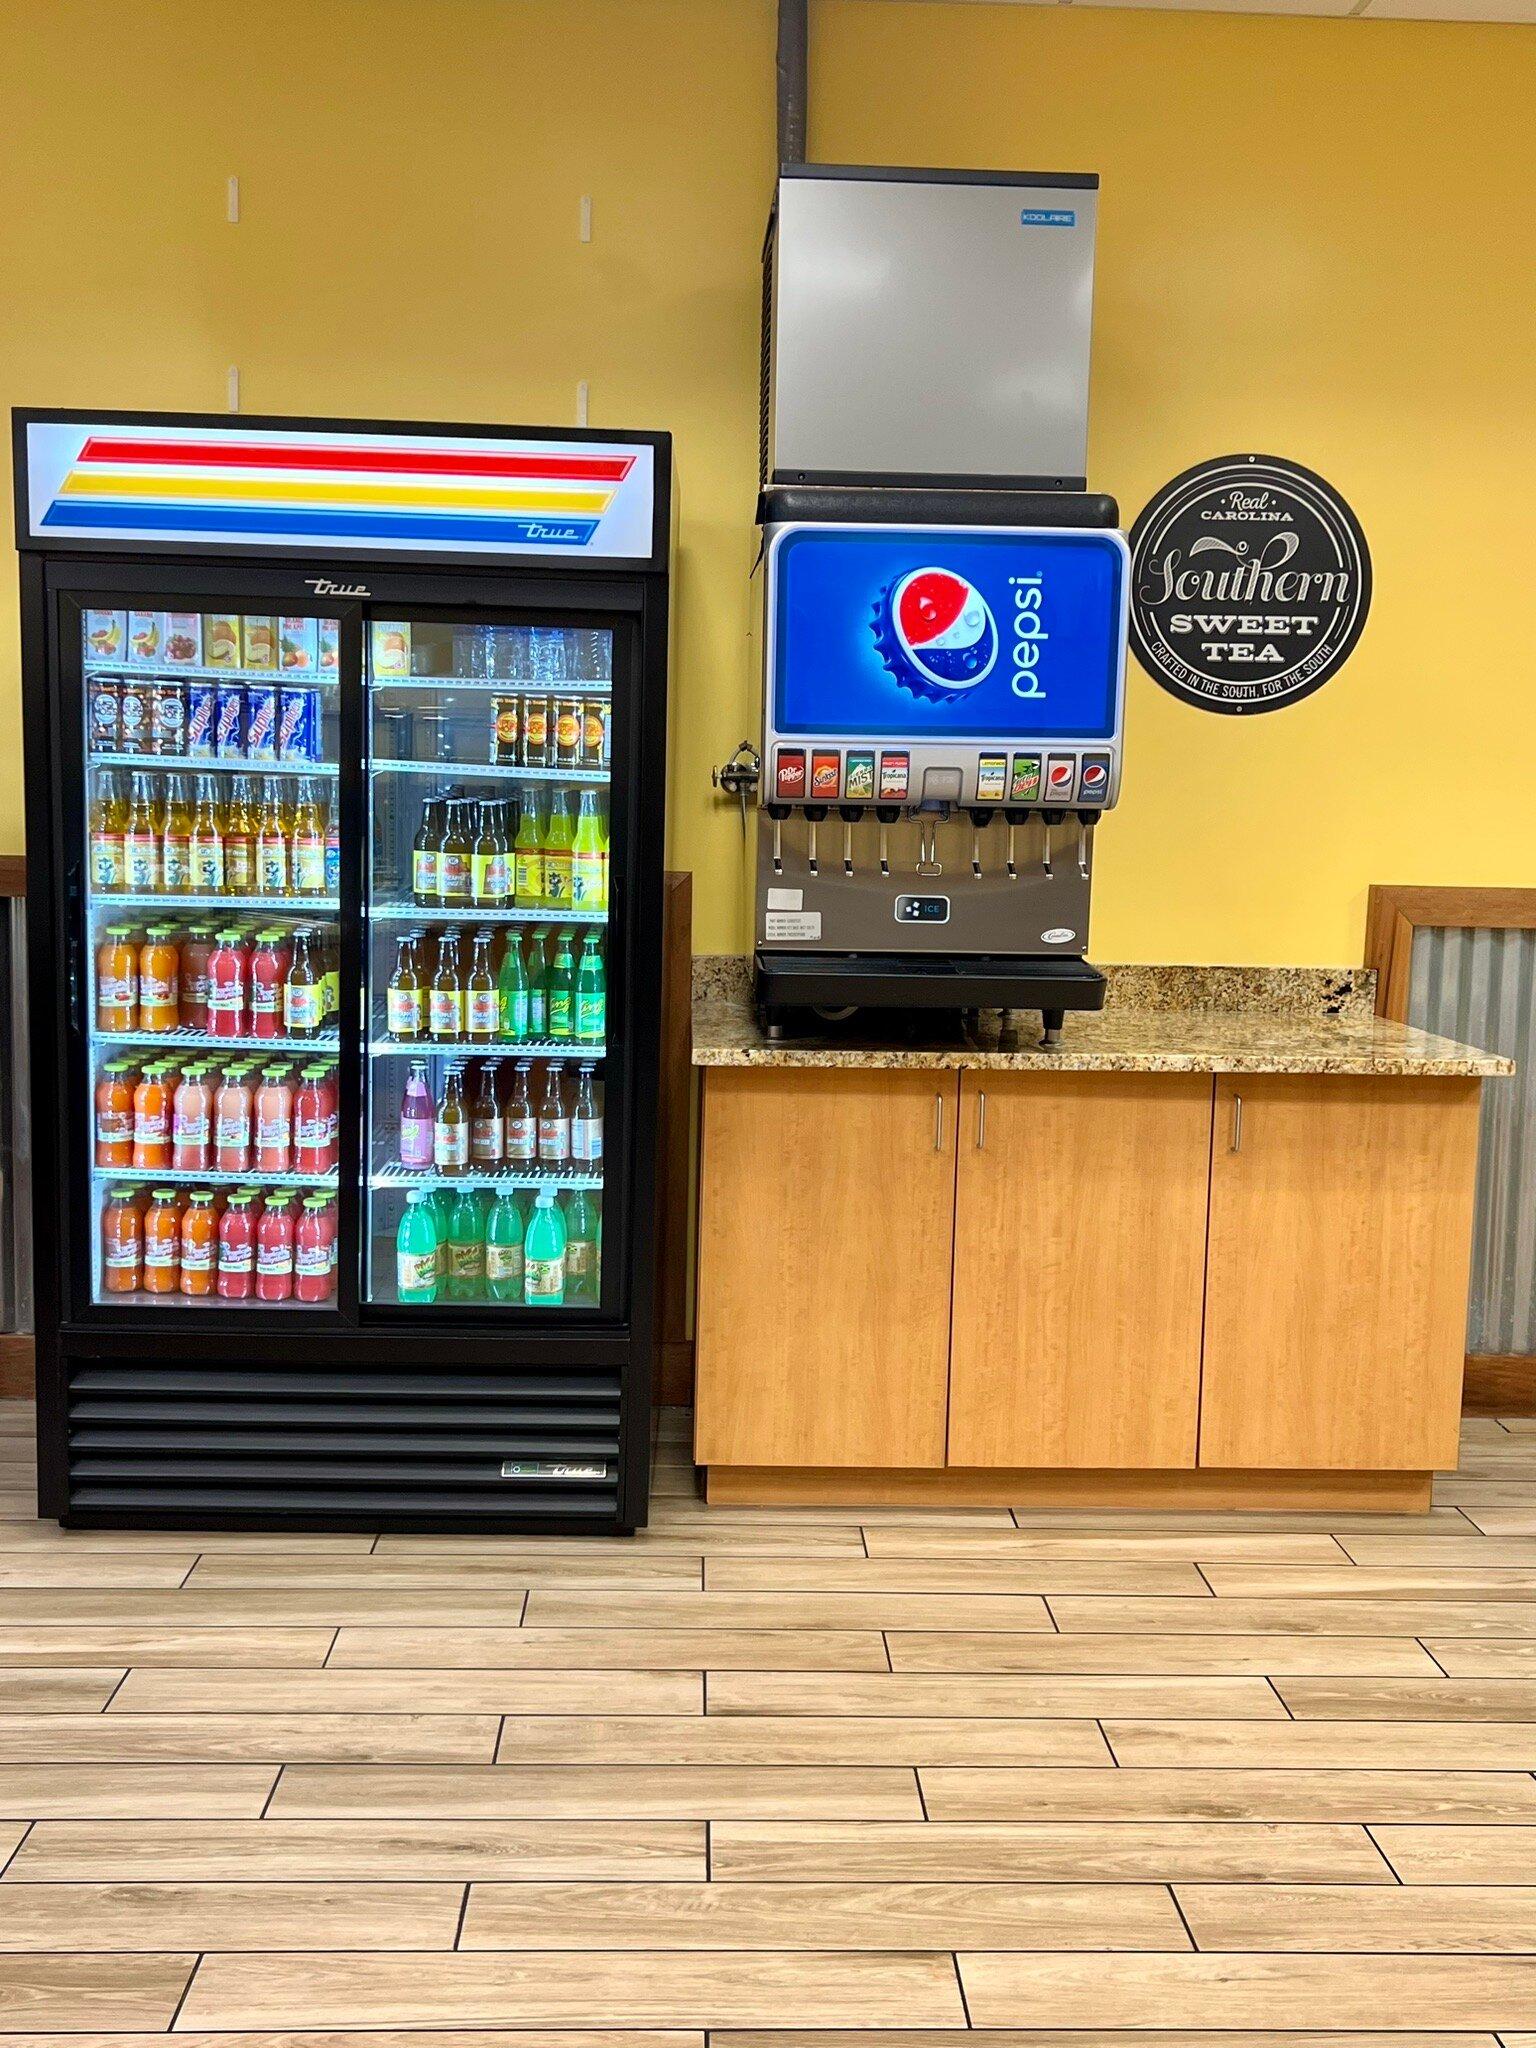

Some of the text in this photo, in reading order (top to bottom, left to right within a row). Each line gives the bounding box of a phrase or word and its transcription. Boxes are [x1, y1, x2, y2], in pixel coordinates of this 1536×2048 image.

[1229, 491, 1269, 510] Real
[1201, 510, 1294, 522] CAROLINA
[1140, 532, 1350, 605] Southern
[1170, 613, 1319, 635] SWEET
[1008, 577, 1048, 698] pepsi
[1201, 642, 1285, 663] TEA
[1151, 641, 1187, 679] CRAFTED
[1187, 675, 1199, 687] IN
[1200, 679, 1219, 696] THE
[1262, 683, 1283, 697] FOR
[1284, 672, 1304, 687] THE
[1303, 643, 1333, 674] SOUTH
[924, 905, 940, 913] ICE
